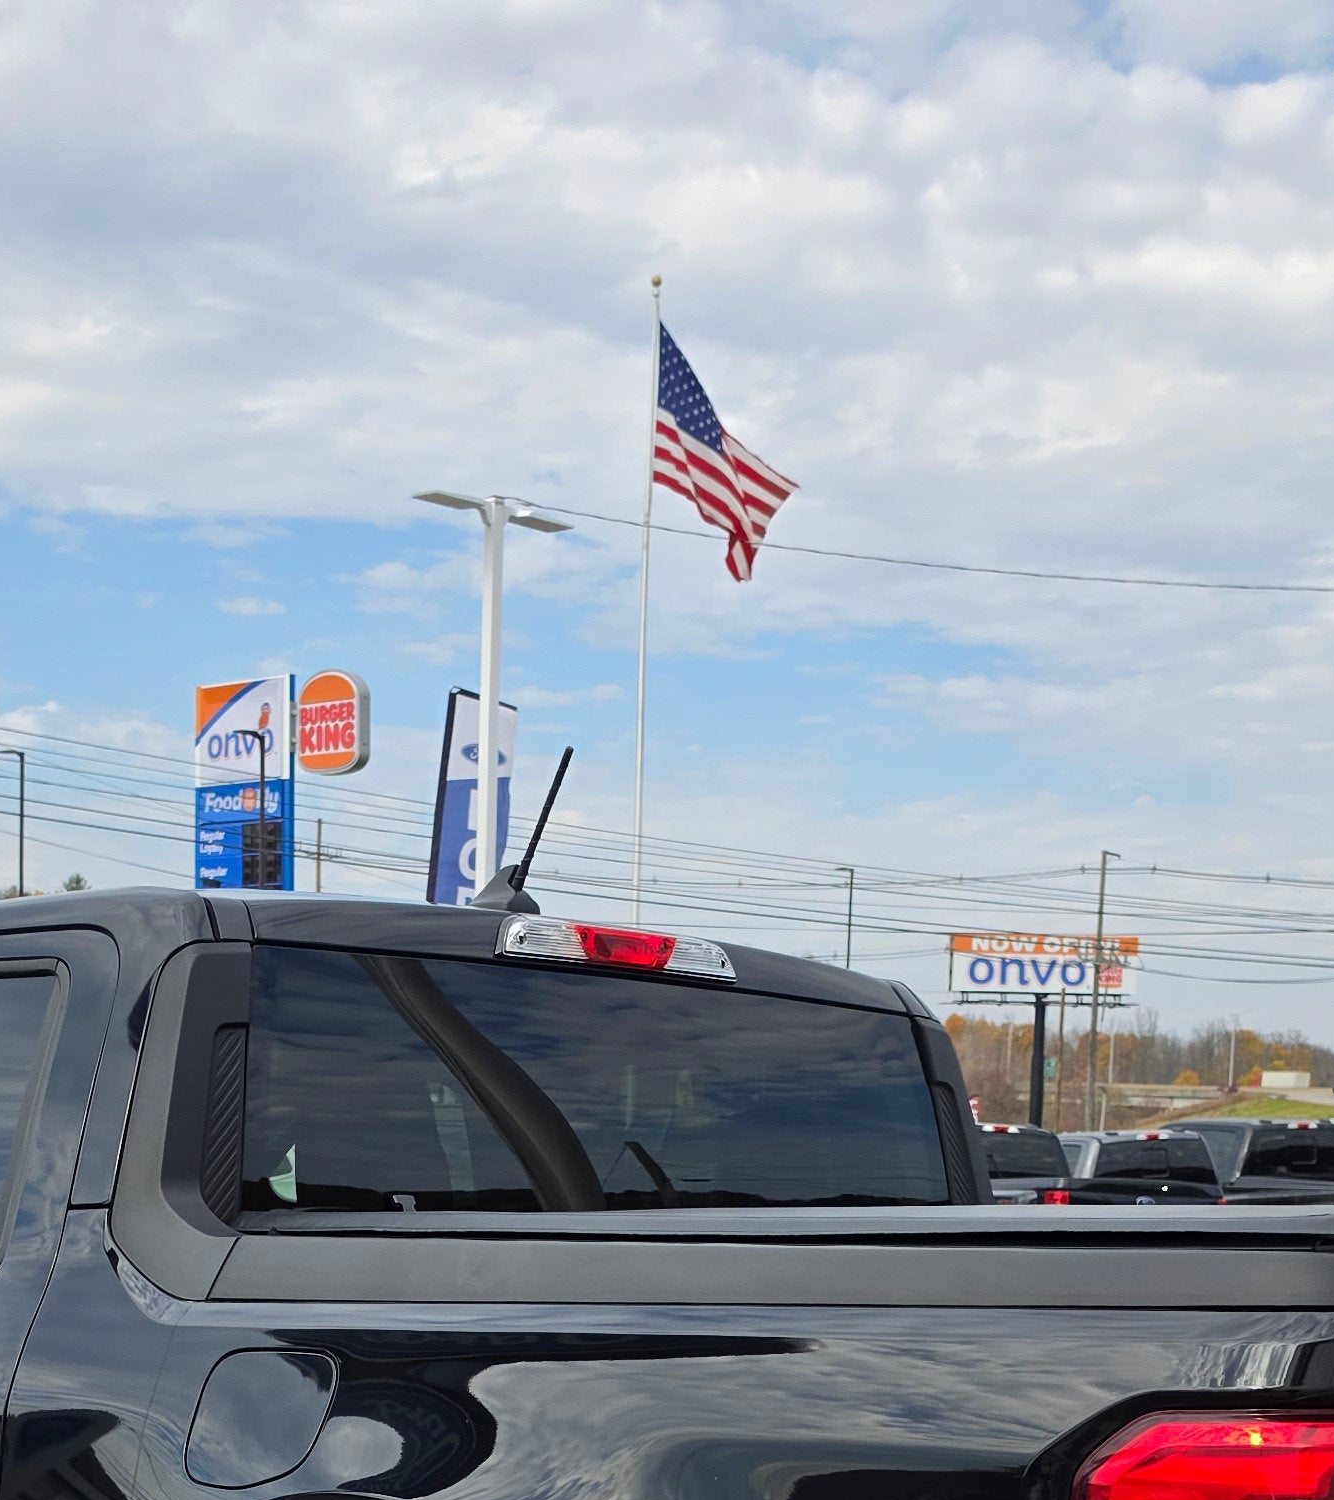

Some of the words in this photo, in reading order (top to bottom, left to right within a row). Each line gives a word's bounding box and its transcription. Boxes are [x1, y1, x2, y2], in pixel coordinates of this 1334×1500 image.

[299, 701, 355, 726] BURGER
[208, 729, 274, 760] onvo
[299, 721, 356, 753] KING
[202, 789, 243, 813] Food
[972, 935, 1038, 952] NOW
[969, 958, 1086, 987] onvo
